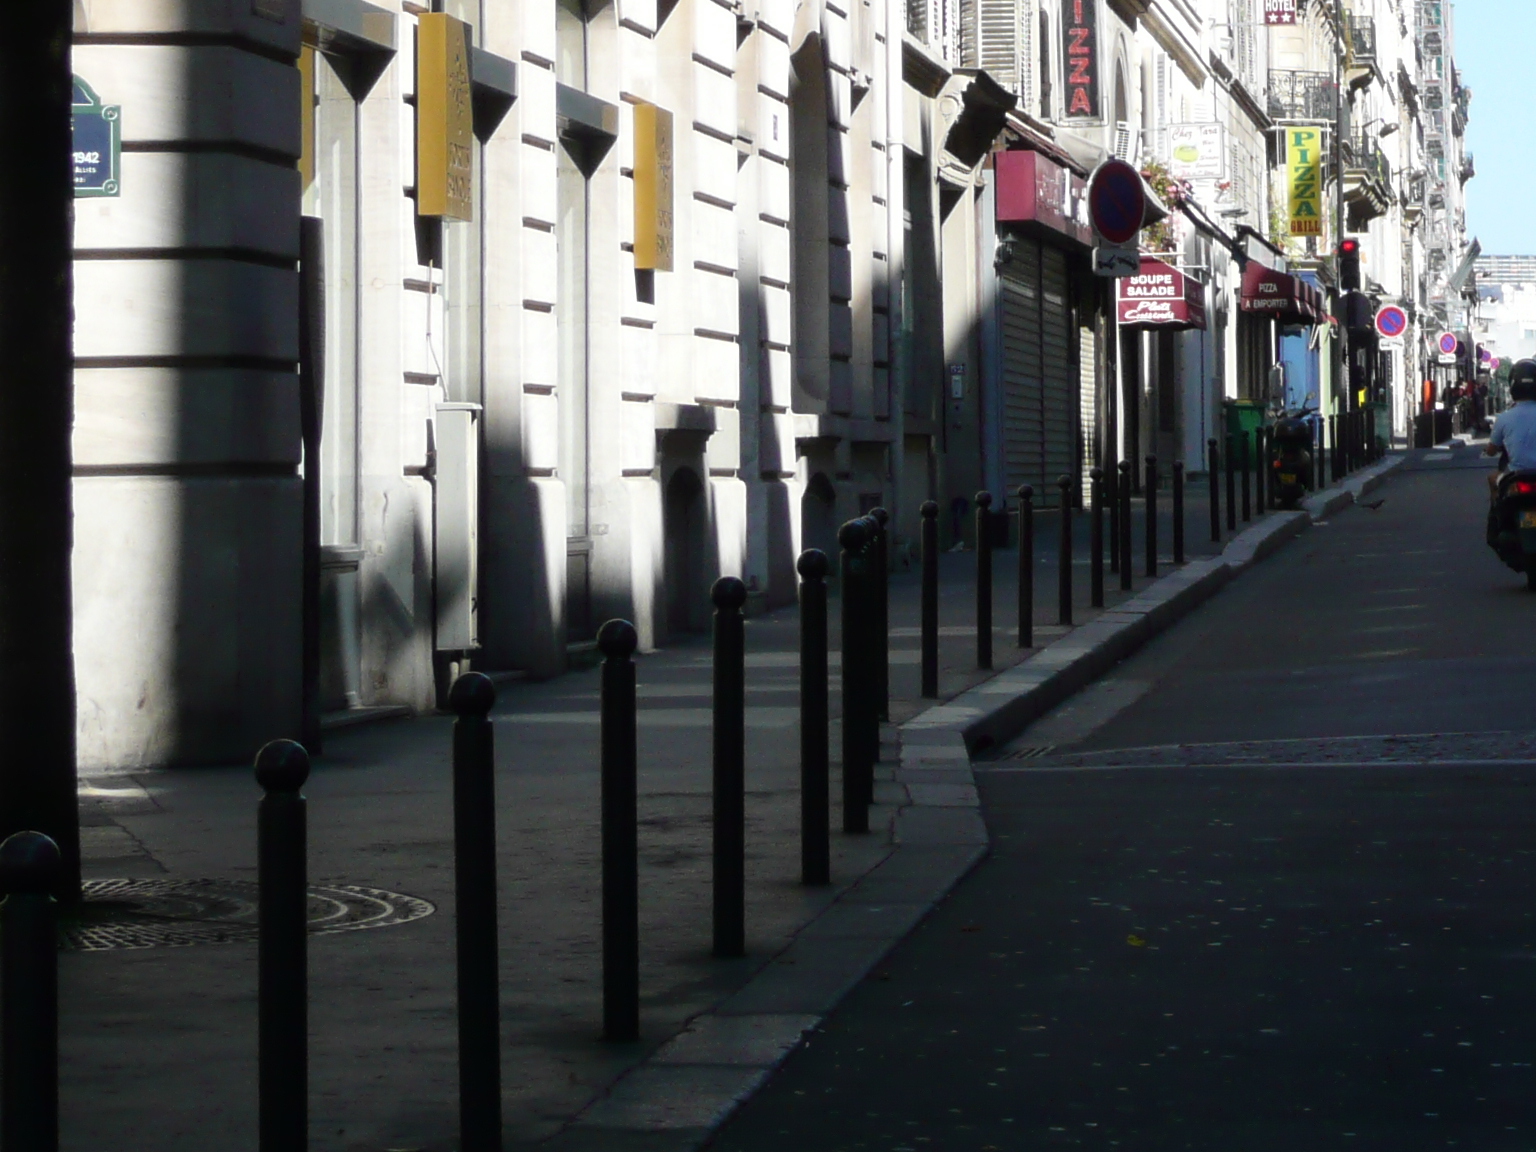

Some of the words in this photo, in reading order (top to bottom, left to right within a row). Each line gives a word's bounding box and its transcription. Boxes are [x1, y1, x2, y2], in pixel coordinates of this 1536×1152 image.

[72, 152, 99, 163] 1942
[1292, 131, 1318, 217] PIZZA
[1290, 220, 1320, 233] GRILL
[1130, 275, 1172, 285] SOUPE
[1127, 286, 1175, 296] SALADE
[1258, 283, 1278, 292] PIZZA
[1137, 301, 1171, 311] Plats
[1253, 299, 1289, 308] EMPORTER
